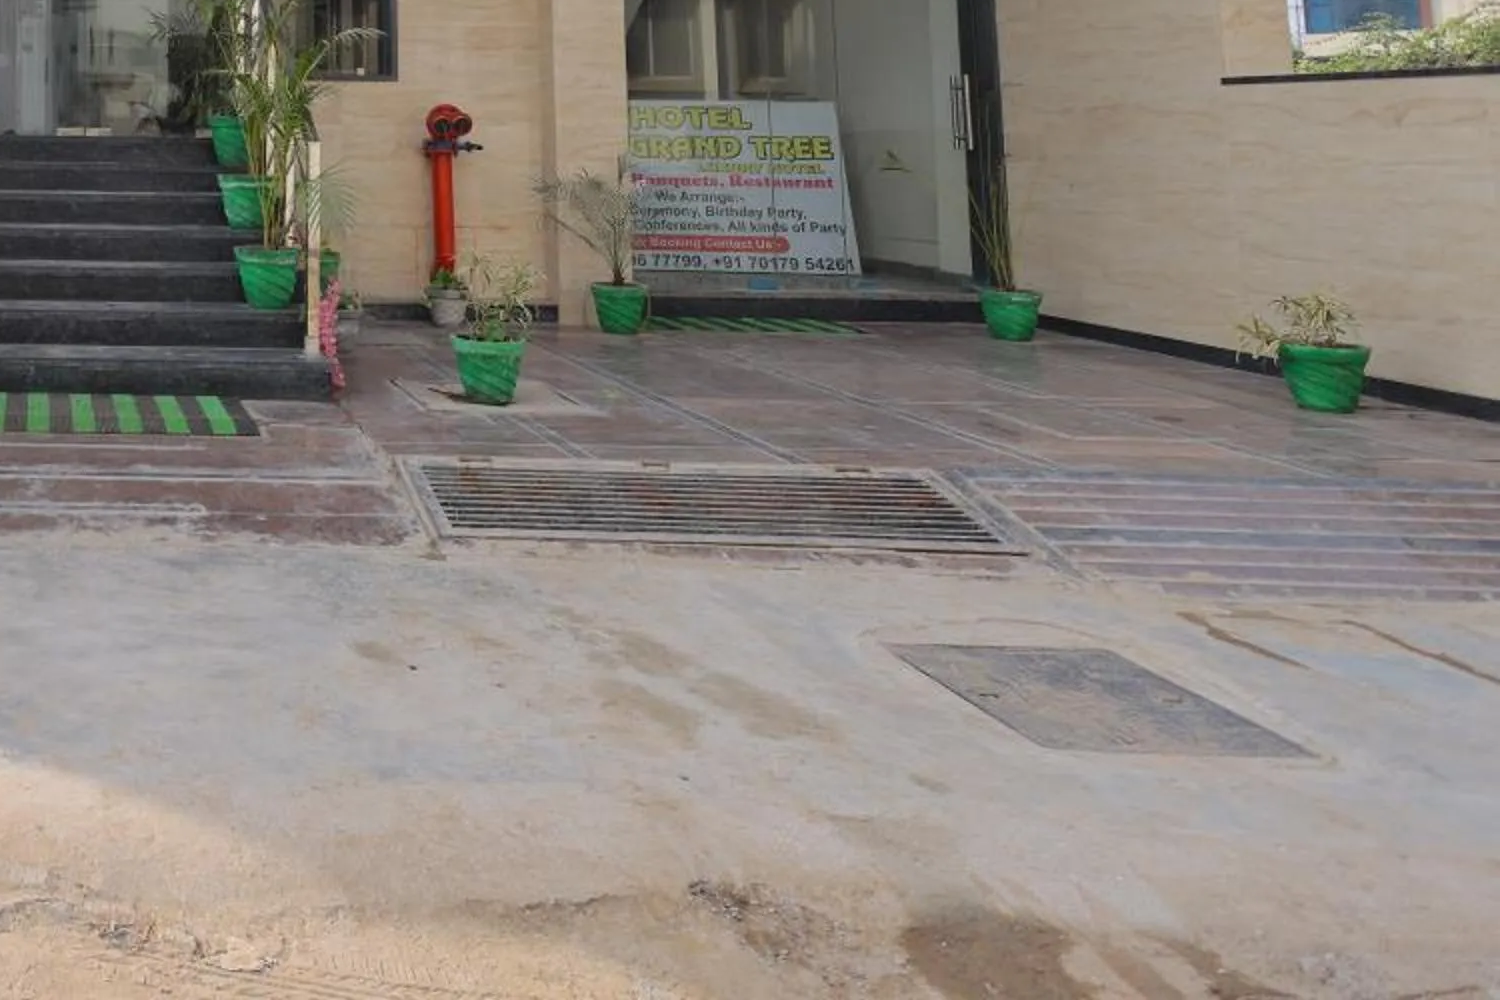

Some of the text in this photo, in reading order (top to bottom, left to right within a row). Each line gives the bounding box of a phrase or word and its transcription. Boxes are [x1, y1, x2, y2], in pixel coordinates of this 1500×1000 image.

[629, 105, 753, 131] HOTEL
[630, 135, 836, 162] GRAND TREE
[654, 191, 677, 202] We
[704, 206, 764, 220] Birthday
[767, 207, 807, 221] Party,
[727, 220, 747, 232] All
[791, 222, 806, 233] of
[809, 222, 847, 235] Party
[704, 238, 752, 249] Contact
[713, 256, 743, 269] +91
